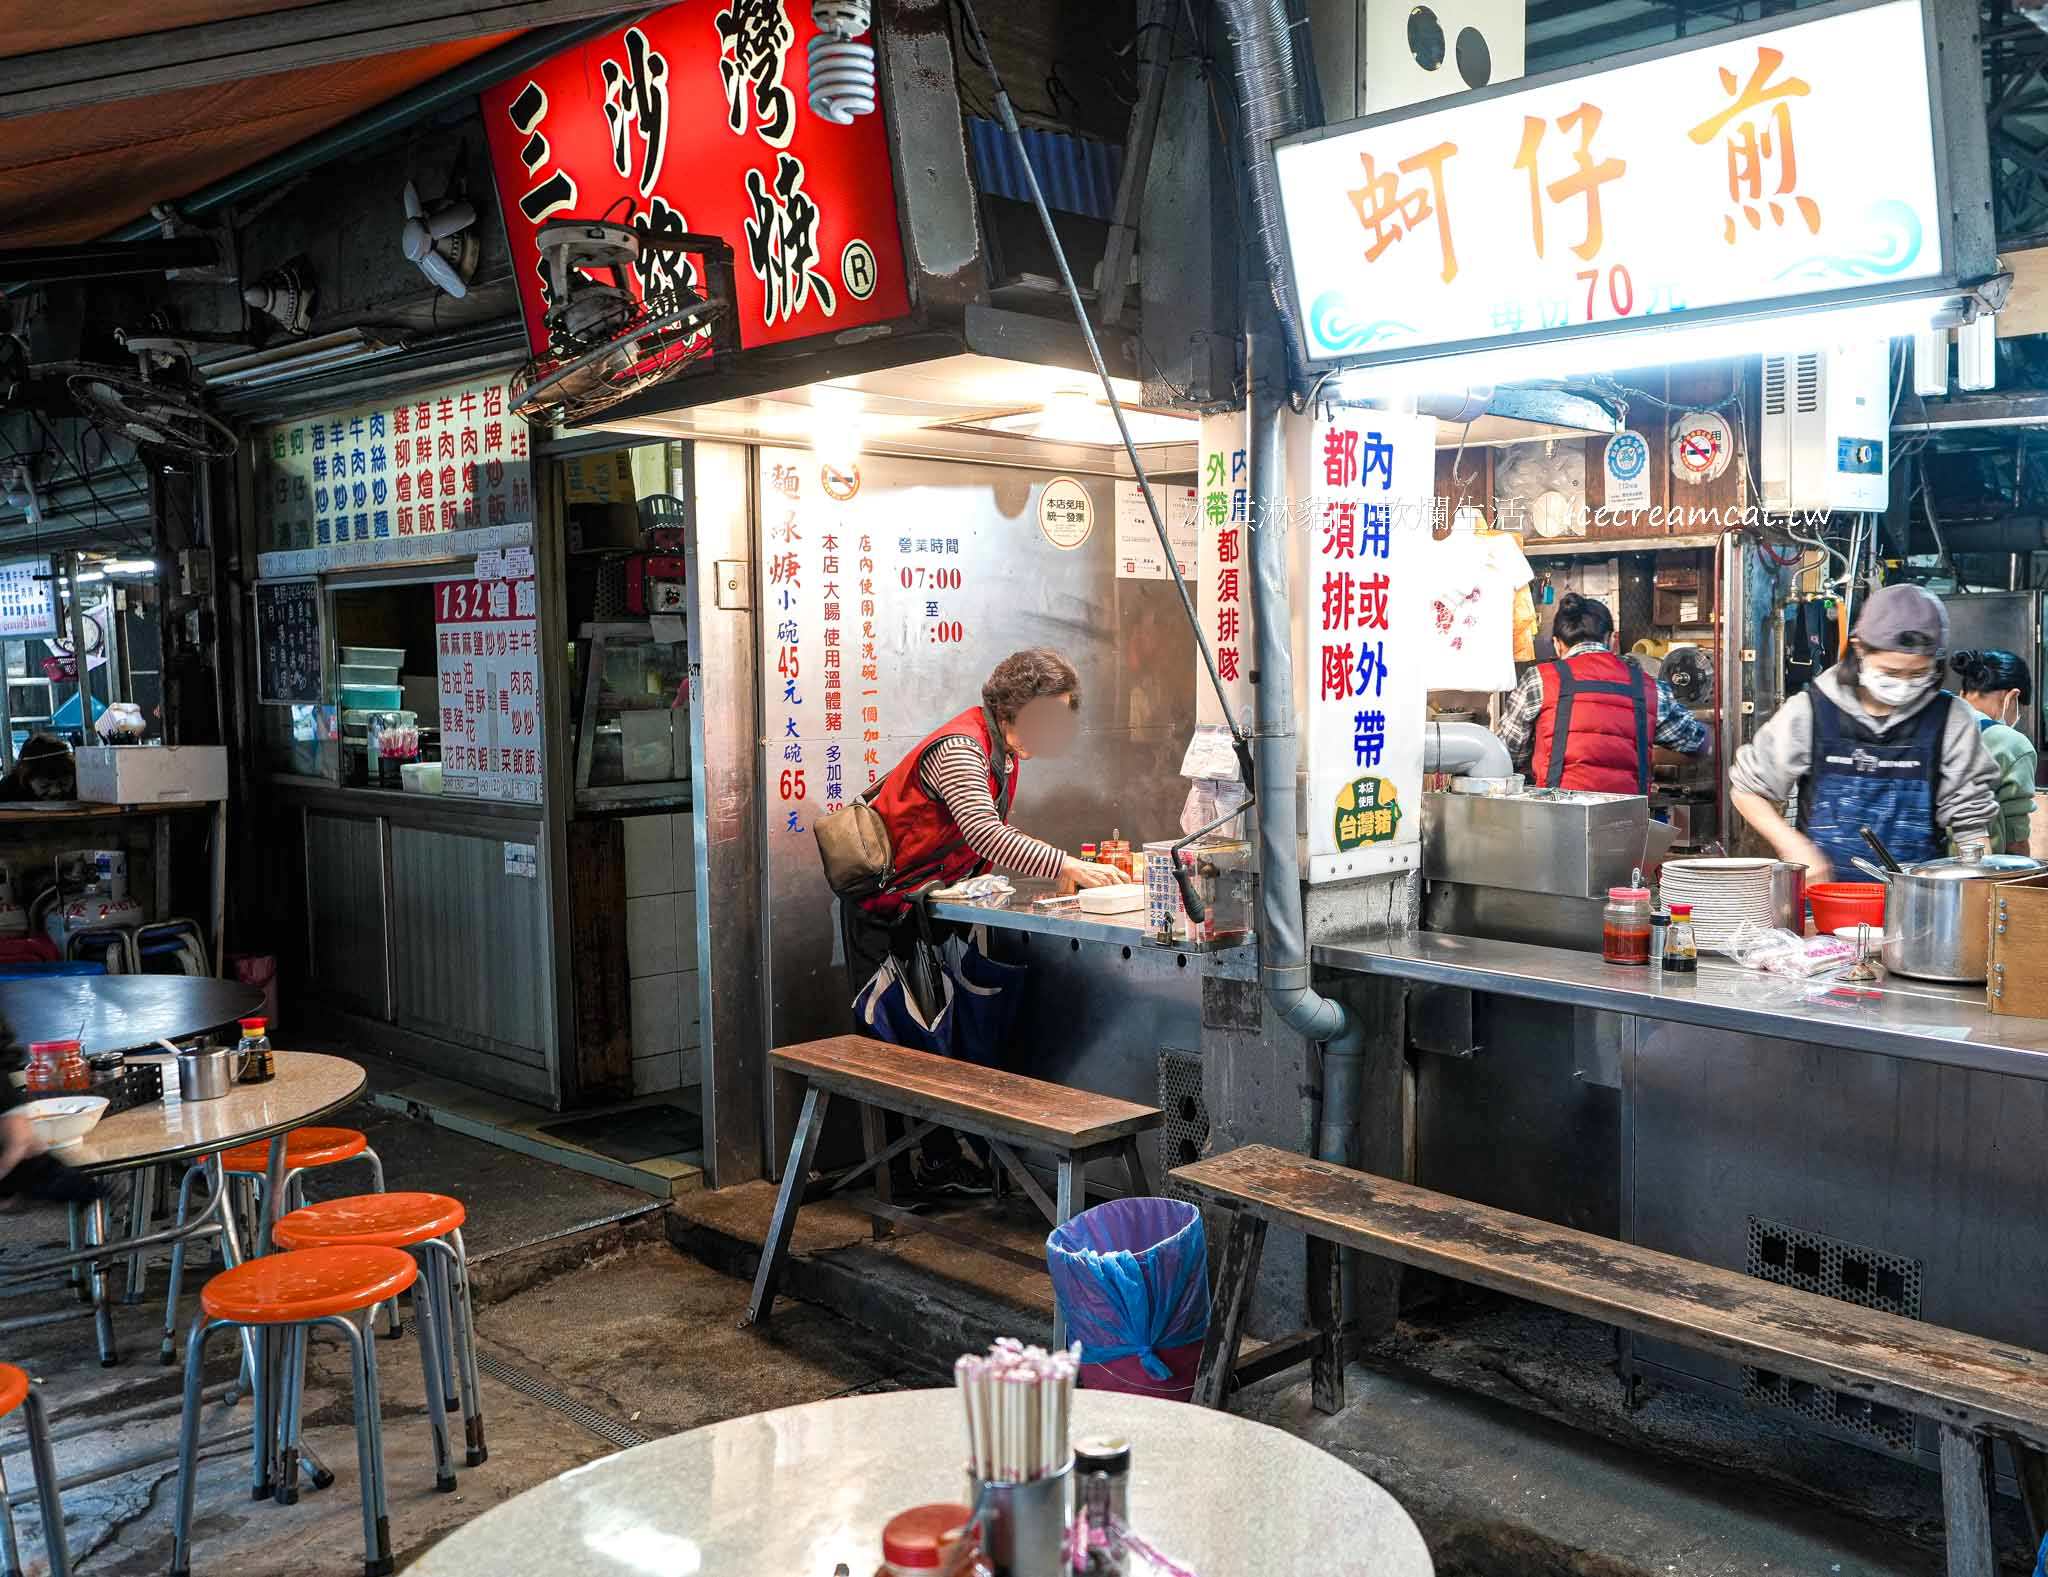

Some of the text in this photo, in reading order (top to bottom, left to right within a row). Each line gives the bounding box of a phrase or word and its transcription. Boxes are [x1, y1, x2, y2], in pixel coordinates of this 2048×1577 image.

[1348, 46, 1822, 284] 蚵仔煎
[311, 423, 332, 546] 海鮮炒麵
[330, 420, 350, 543] 羊肉炒麵
[350, 416, 369, 540] 牛肉炒麵
[369, 411, 390, 538] 肉絲炒麵
[392, 404, 414, 536] 雞柳燴飯
[414, 400, 437, 533] 海鮮燴飯
[437, 395, 459, 530] 羊肉燴飯
[459, 389, 482, 528] 牛肉燴飯
[482, 384, 506, 525] 招牌炒飯
[1206, 451, 1228, 526] 外帶
[899, 537, 960, 554] 營業時間
[900, 567, 962, 590] 07:00
[926, 601, 939, 618] 至
[1217, 529, 1239, 683] 都須排隊
[1321, 427, 1359, 702] 都須排隊
[1354, 432, 1394, 769] 內用或外帶
[509, 629, 524, 775] 羊肉炒飯
[521, 629, 536, 775] 牛肉炒飯
[1339, 808, 1393, 842] 台灣豬
[1358, 782, 1374, 794] 本店
